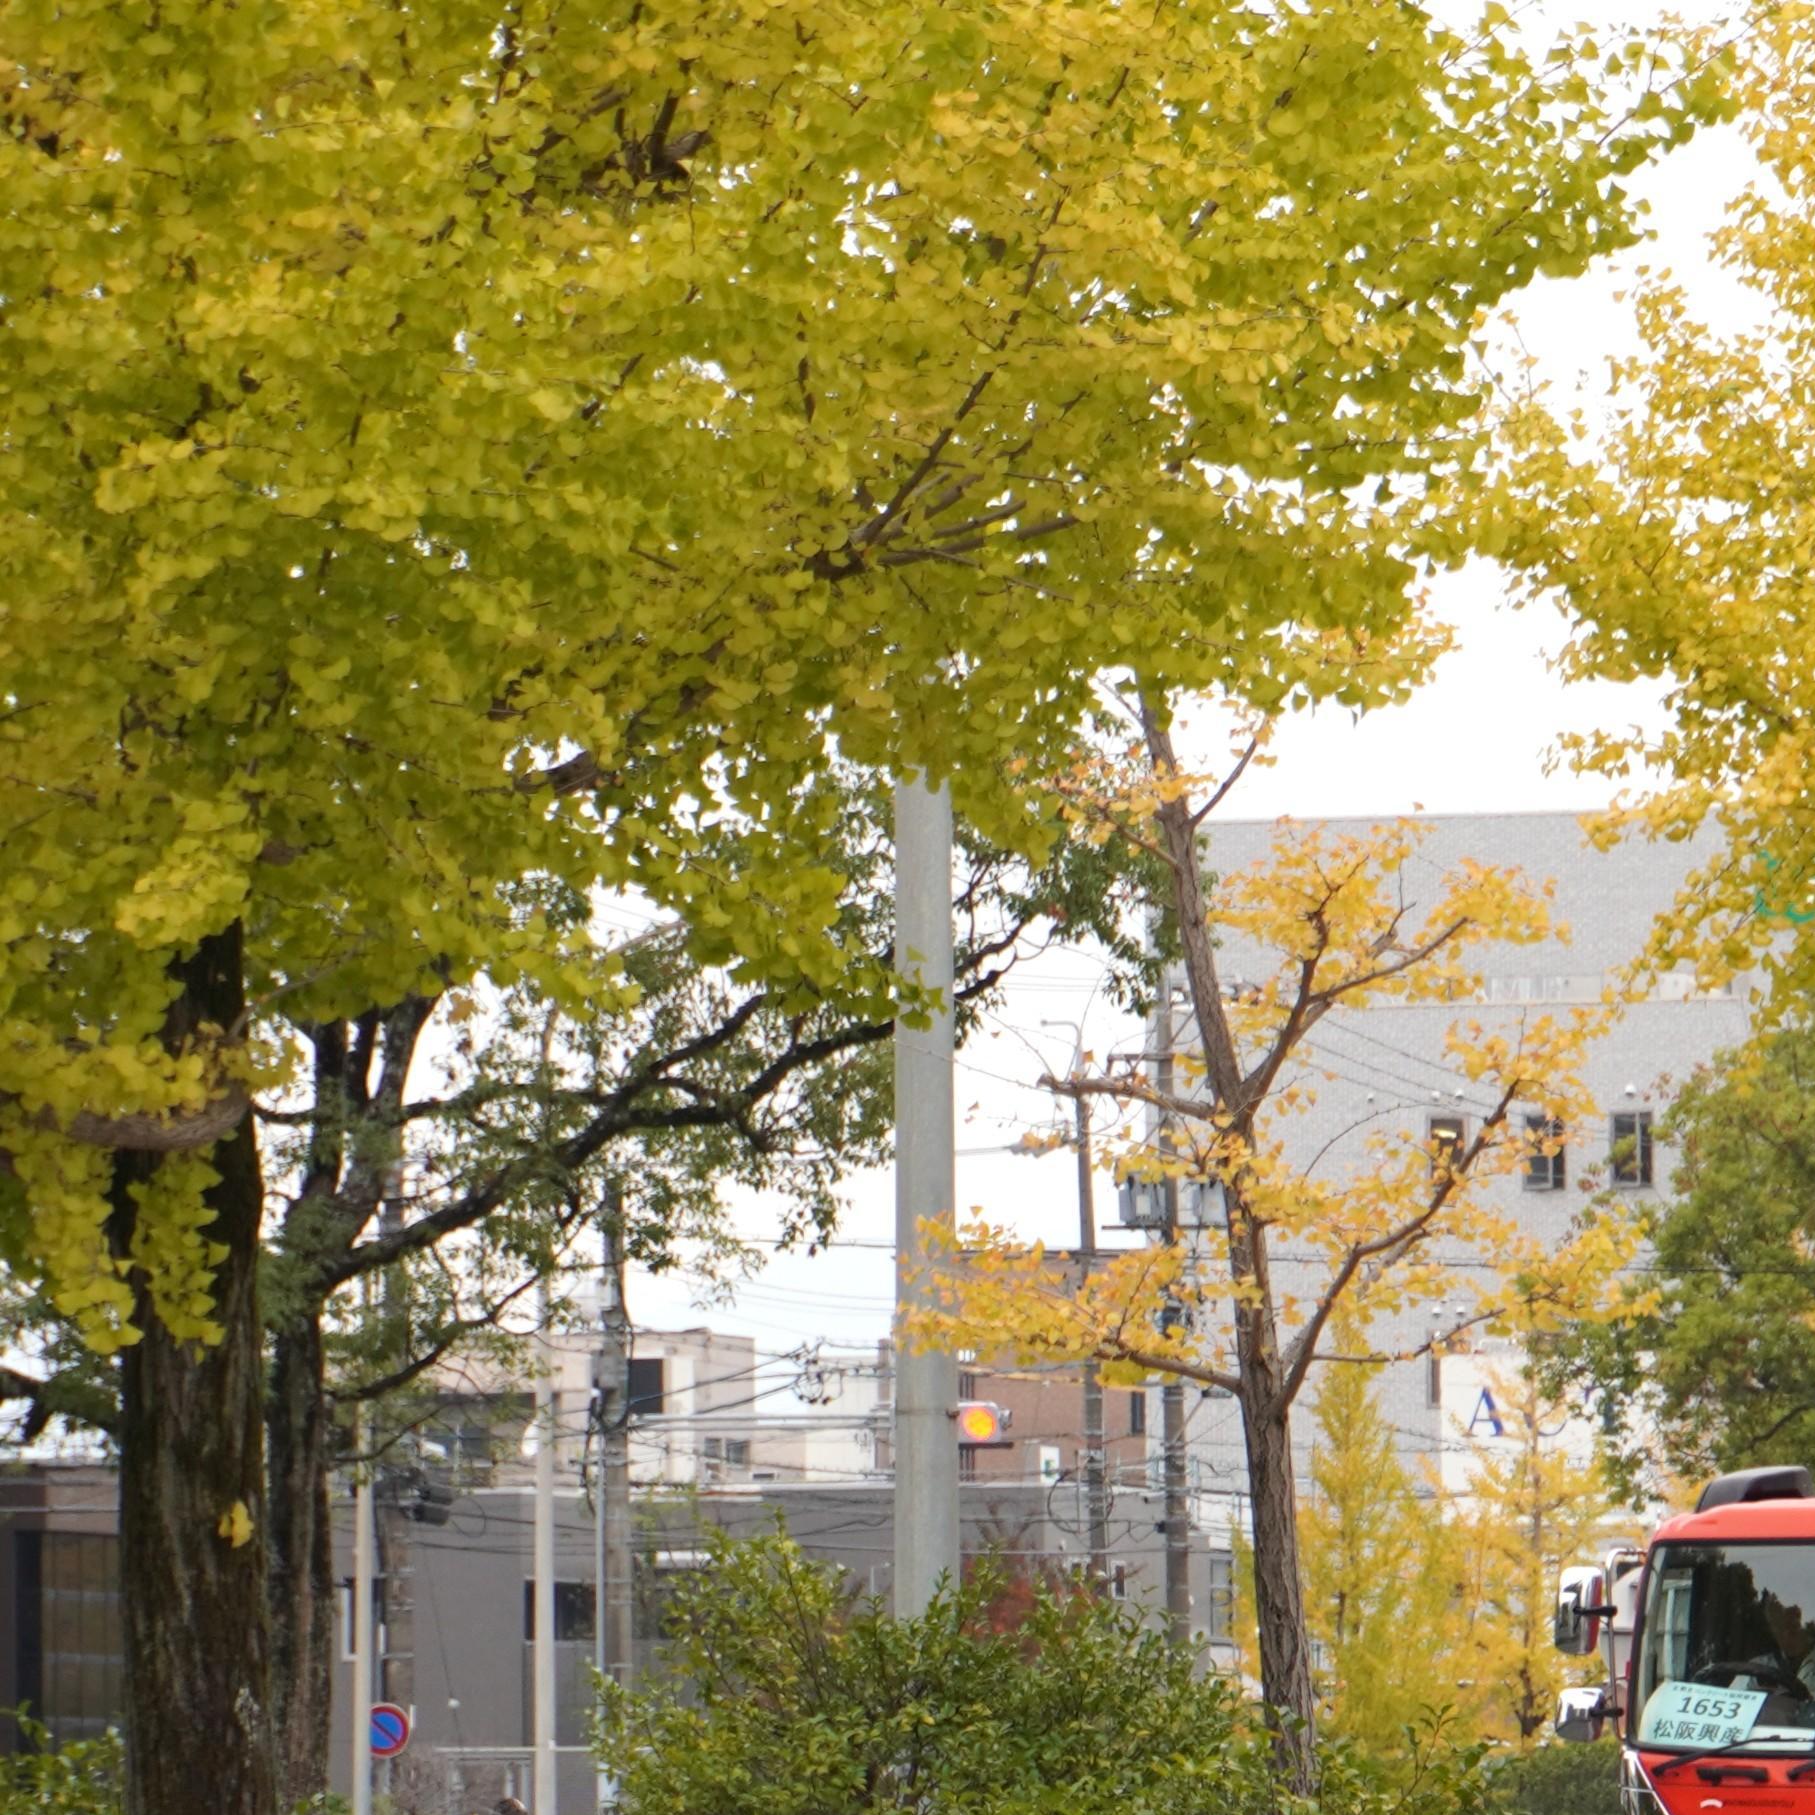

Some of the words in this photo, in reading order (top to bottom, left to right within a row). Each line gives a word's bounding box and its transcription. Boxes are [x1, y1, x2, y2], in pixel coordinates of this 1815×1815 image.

[1677, 1696, 1742, 1720] 1653
[1653, 1718, 1744, 1744] 松阪興産
